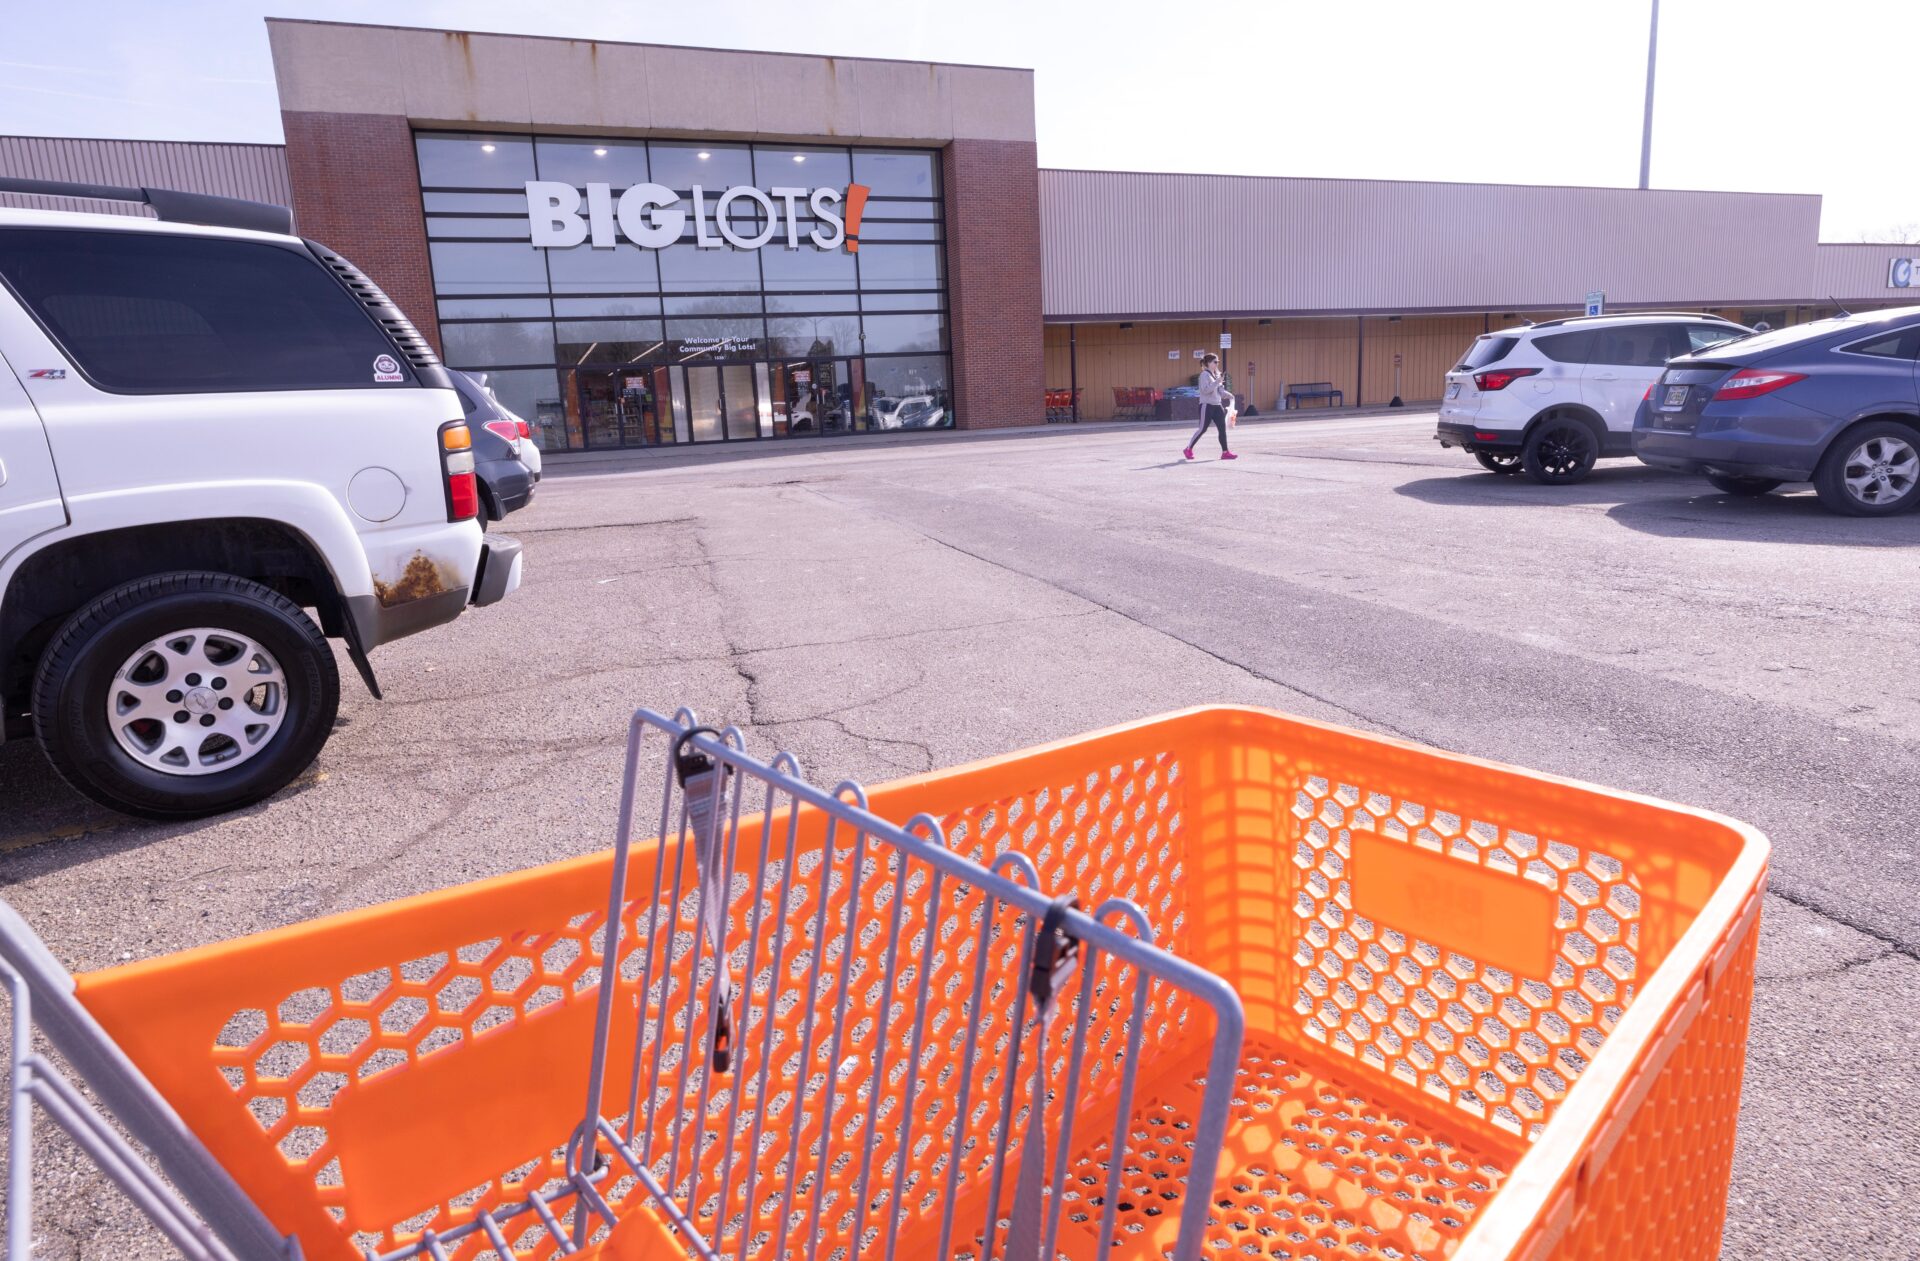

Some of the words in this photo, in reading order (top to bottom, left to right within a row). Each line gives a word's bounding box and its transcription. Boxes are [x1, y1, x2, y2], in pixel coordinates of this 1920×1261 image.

[525, 181, 685, 248] BIG
[692, 183, 871, 253] LOTS!
[679, 344, 722, 353] Community
[724, 343, 736, 352] Big
